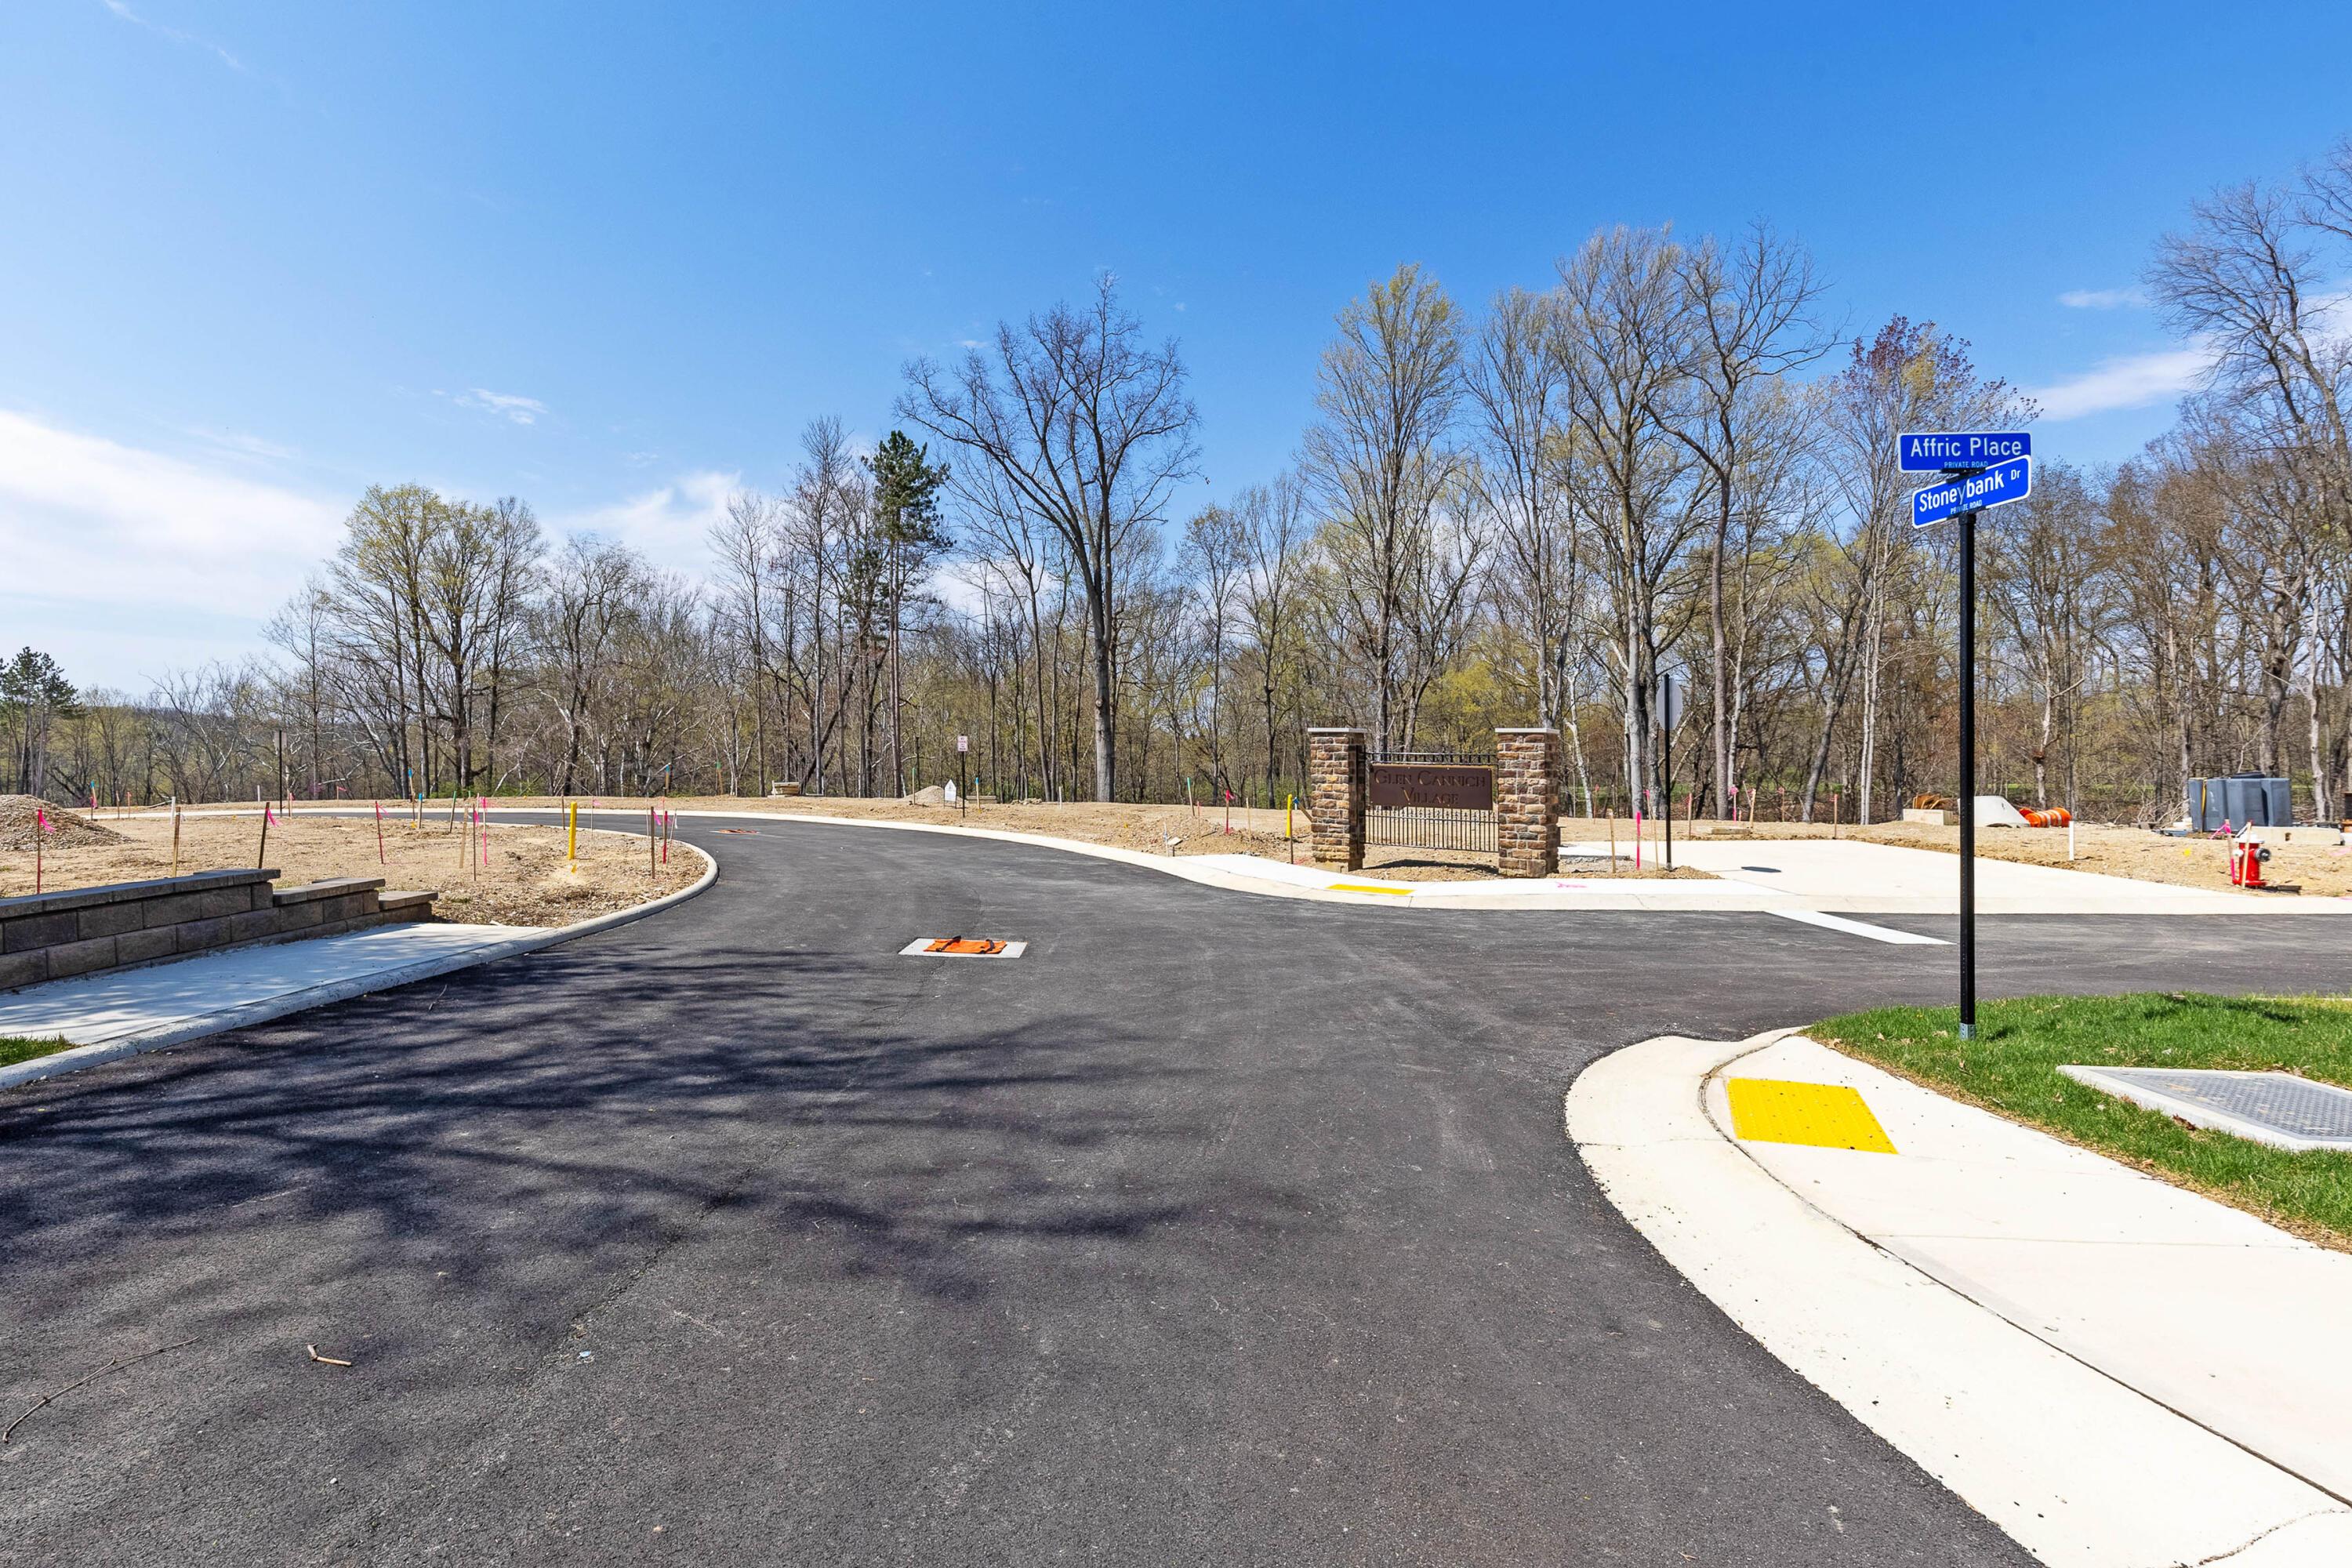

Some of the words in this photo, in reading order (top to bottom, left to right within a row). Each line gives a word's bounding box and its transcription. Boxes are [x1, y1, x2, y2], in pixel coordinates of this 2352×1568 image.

[1911, 437, 1961, 457] Affric
[1970, 437, 2022, 456] Place
[1919, 470, 2005, 512] Stoneybank
[2010, 469, 2021, 481] Dr
[1969, 499, 1983, 509] ROAD
[1374, 769, 1412, 786] GLEN
[1417, 770, 1486, 787] CANNICH
[1402, 787, 1460, 804] VILLAGE
